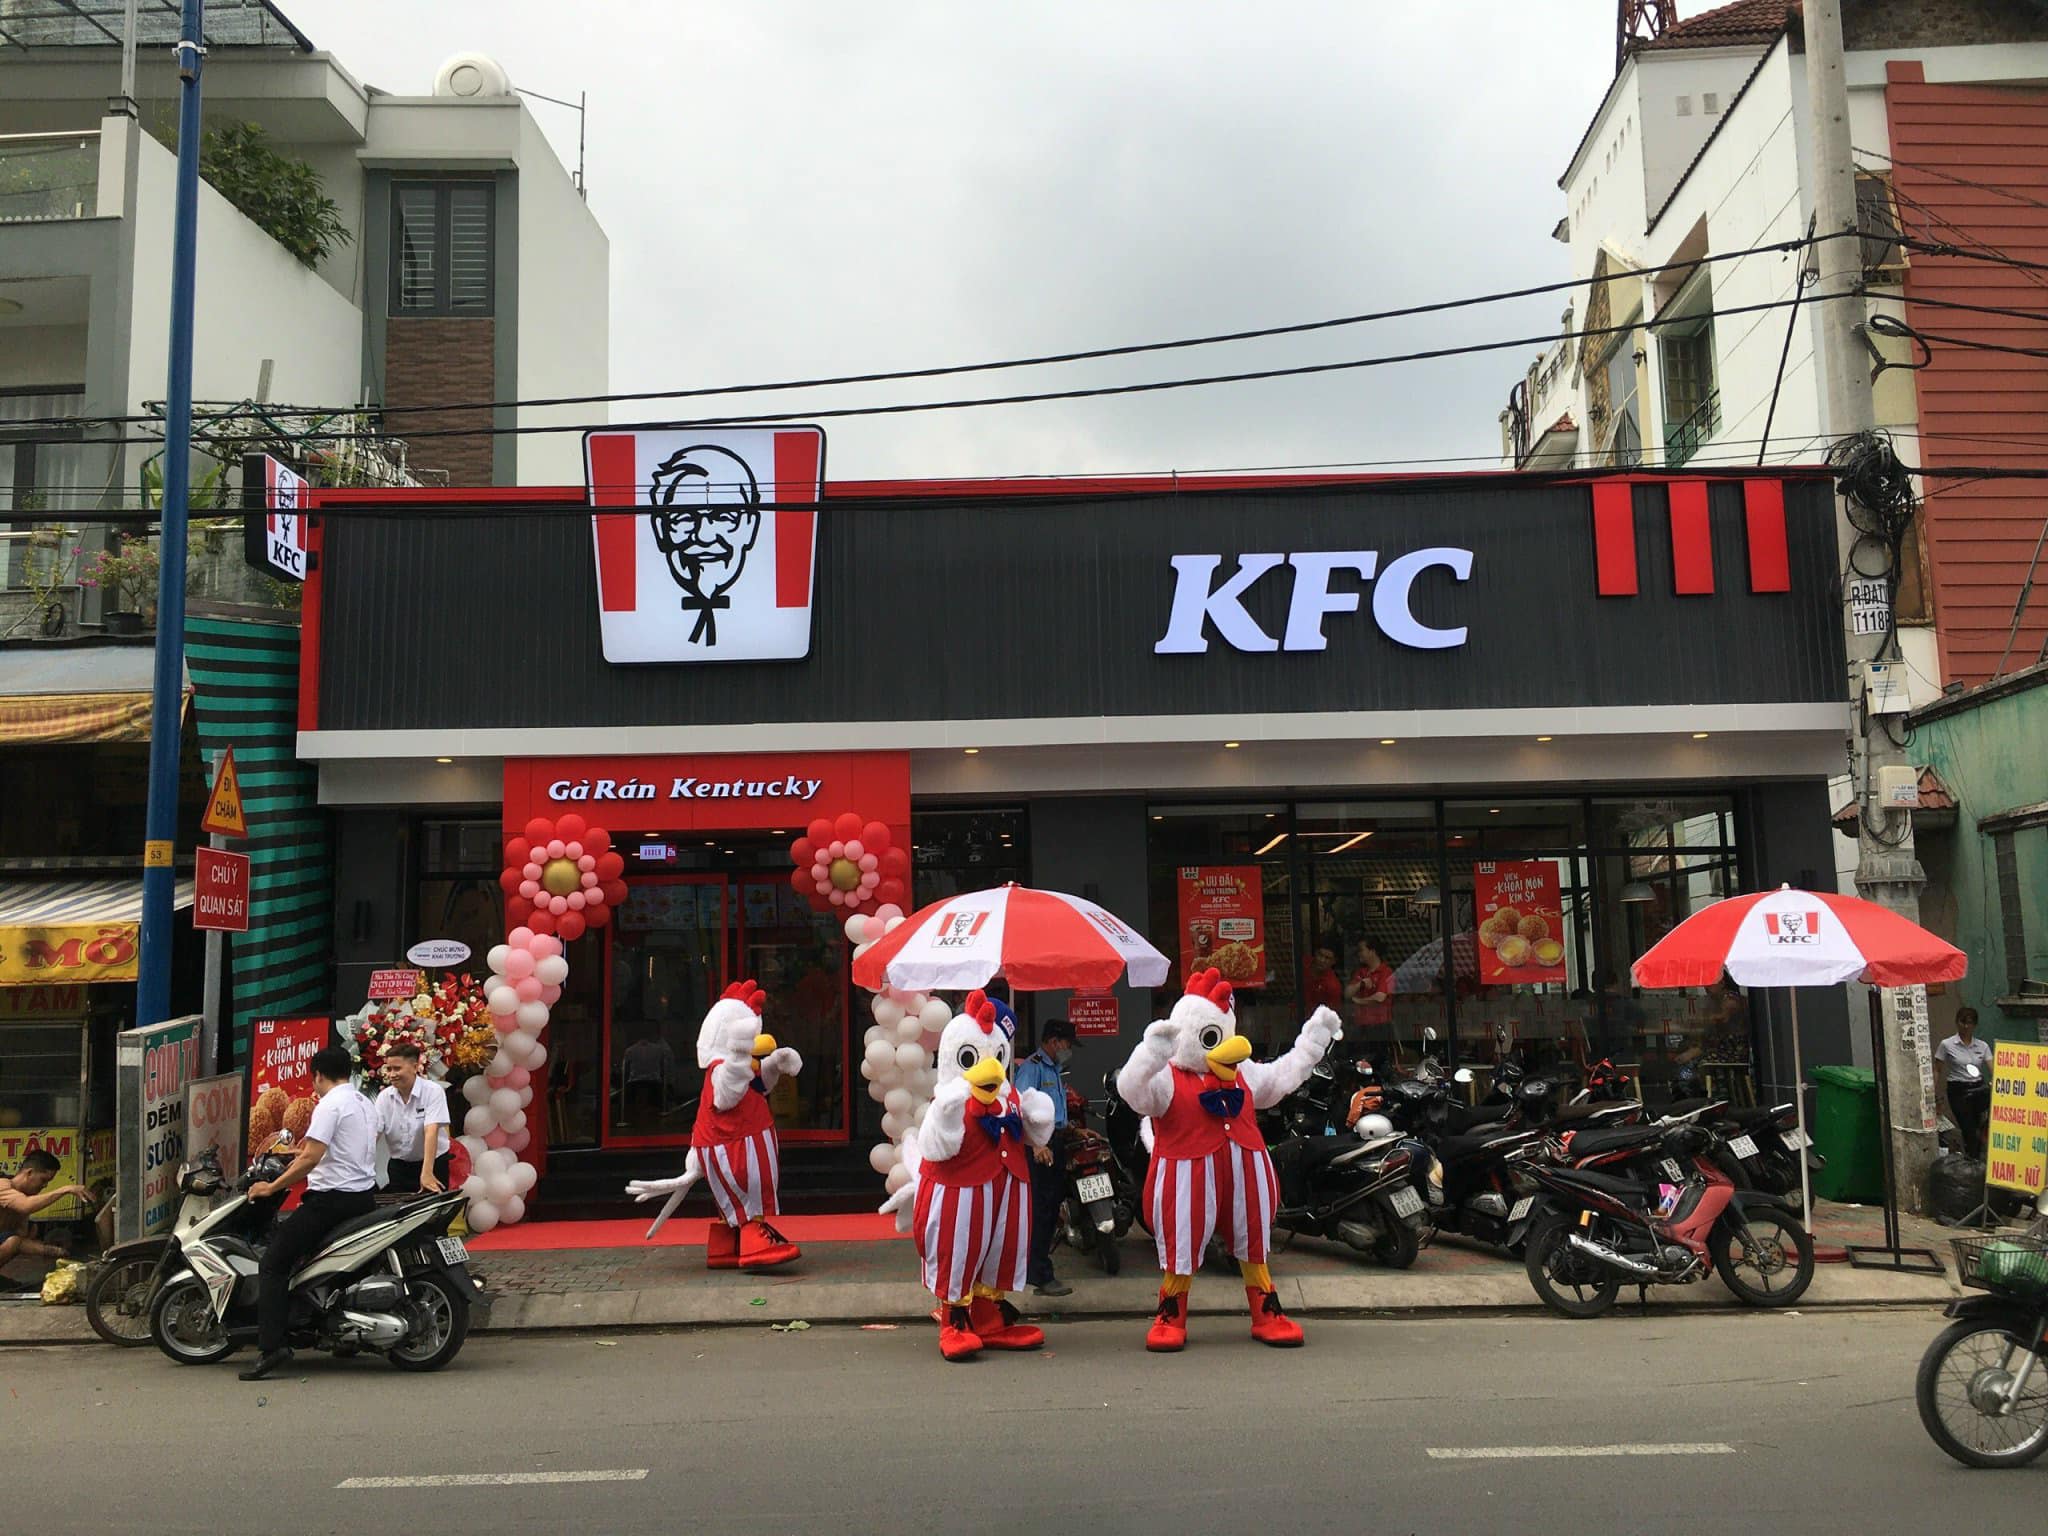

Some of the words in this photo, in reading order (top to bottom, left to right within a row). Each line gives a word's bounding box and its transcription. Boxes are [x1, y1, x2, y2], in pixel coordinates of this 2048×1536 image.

[273, 540, 300, 573] KFC
[1154, 547, 1474, 654] KFC
[669, 775, 821, 800] Kentucky
[211, 862, 231, 884] CHÚ
[231, 863, 238, 884] Ý
[1497, 880, 1523, 894] KHOAI
[200, 895, 226, 915] QUAN
[227, 894, 243, 916] SÁT
[938, 937, 969, 946] KFC
[1777, 935, 1812, 944] KFC
[267, 1046, 296, 1068] KHOAI
[278, 1065, 293, 1082] KIM
[295, 1061, 307, 1078] SA
[147, 1101, 182, 1131] ĐÊM
[1992, 1105, 2025, 1125] MASSAGE
[1992, 1132, 2004, 1149] VAI
[1992, 1160, 2015, 1182] NAM
